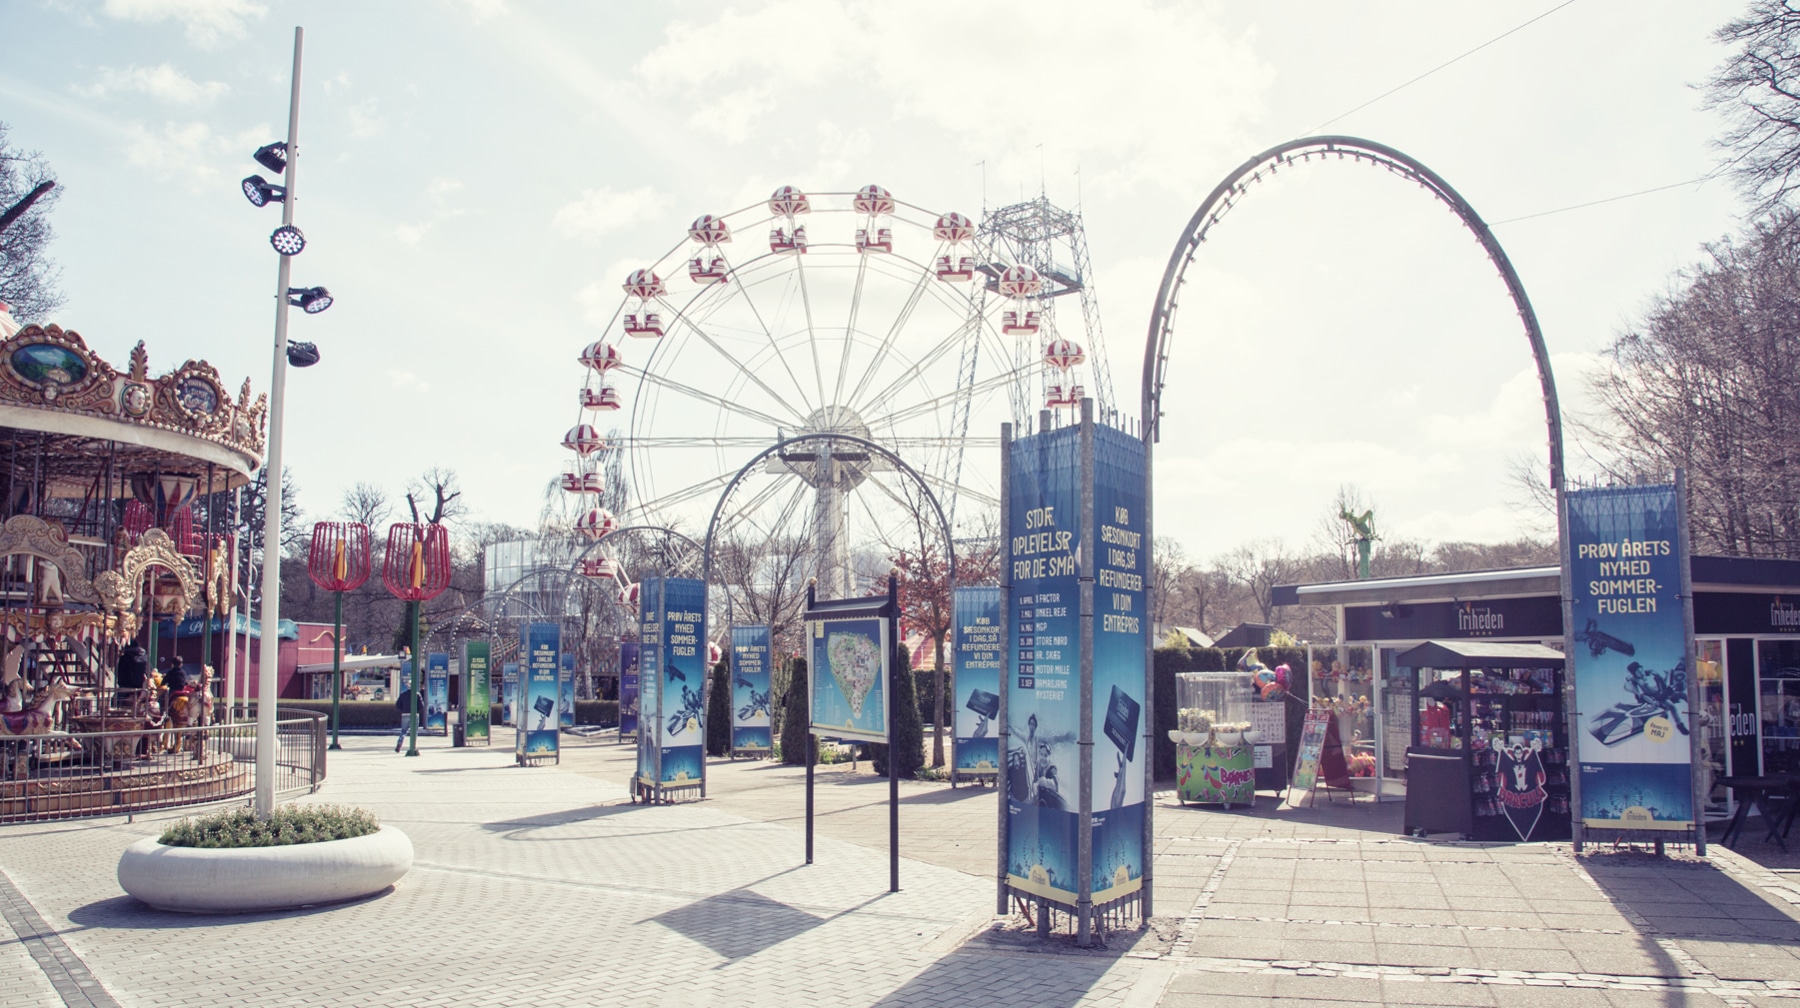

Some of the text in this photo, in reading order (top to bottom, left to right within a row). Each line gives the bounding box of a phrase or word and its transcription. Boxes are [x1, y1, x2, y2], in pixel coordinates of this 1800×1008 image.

[1115, 506, 1129, 525] KØB
[1101, 525, 1141, 549] SÆSONKORT
[1579, 538, 1670, 559] PRØV ÅRETS
[1014, 560, 1031, 580] FOR
[1033, 558, 1047, 578] DE
[1600, 560, 1651, 577] NYHED
[1099, 568, 1143, 591] REFUNDERER
[1589, 579, 1663, 595] SOMMER-
[1113, 593, 1132, 611] VI DIN
[1597, 598, 1657, 614] FUGLEN
[1103, 611, 1140, 634] ENTRÉPRIS
[1458, 607, 1504, 630] friheden
[963, 626, 1000, 634] SÆSONKOR
[962, 643, 1000, 651] REFUNDERE
